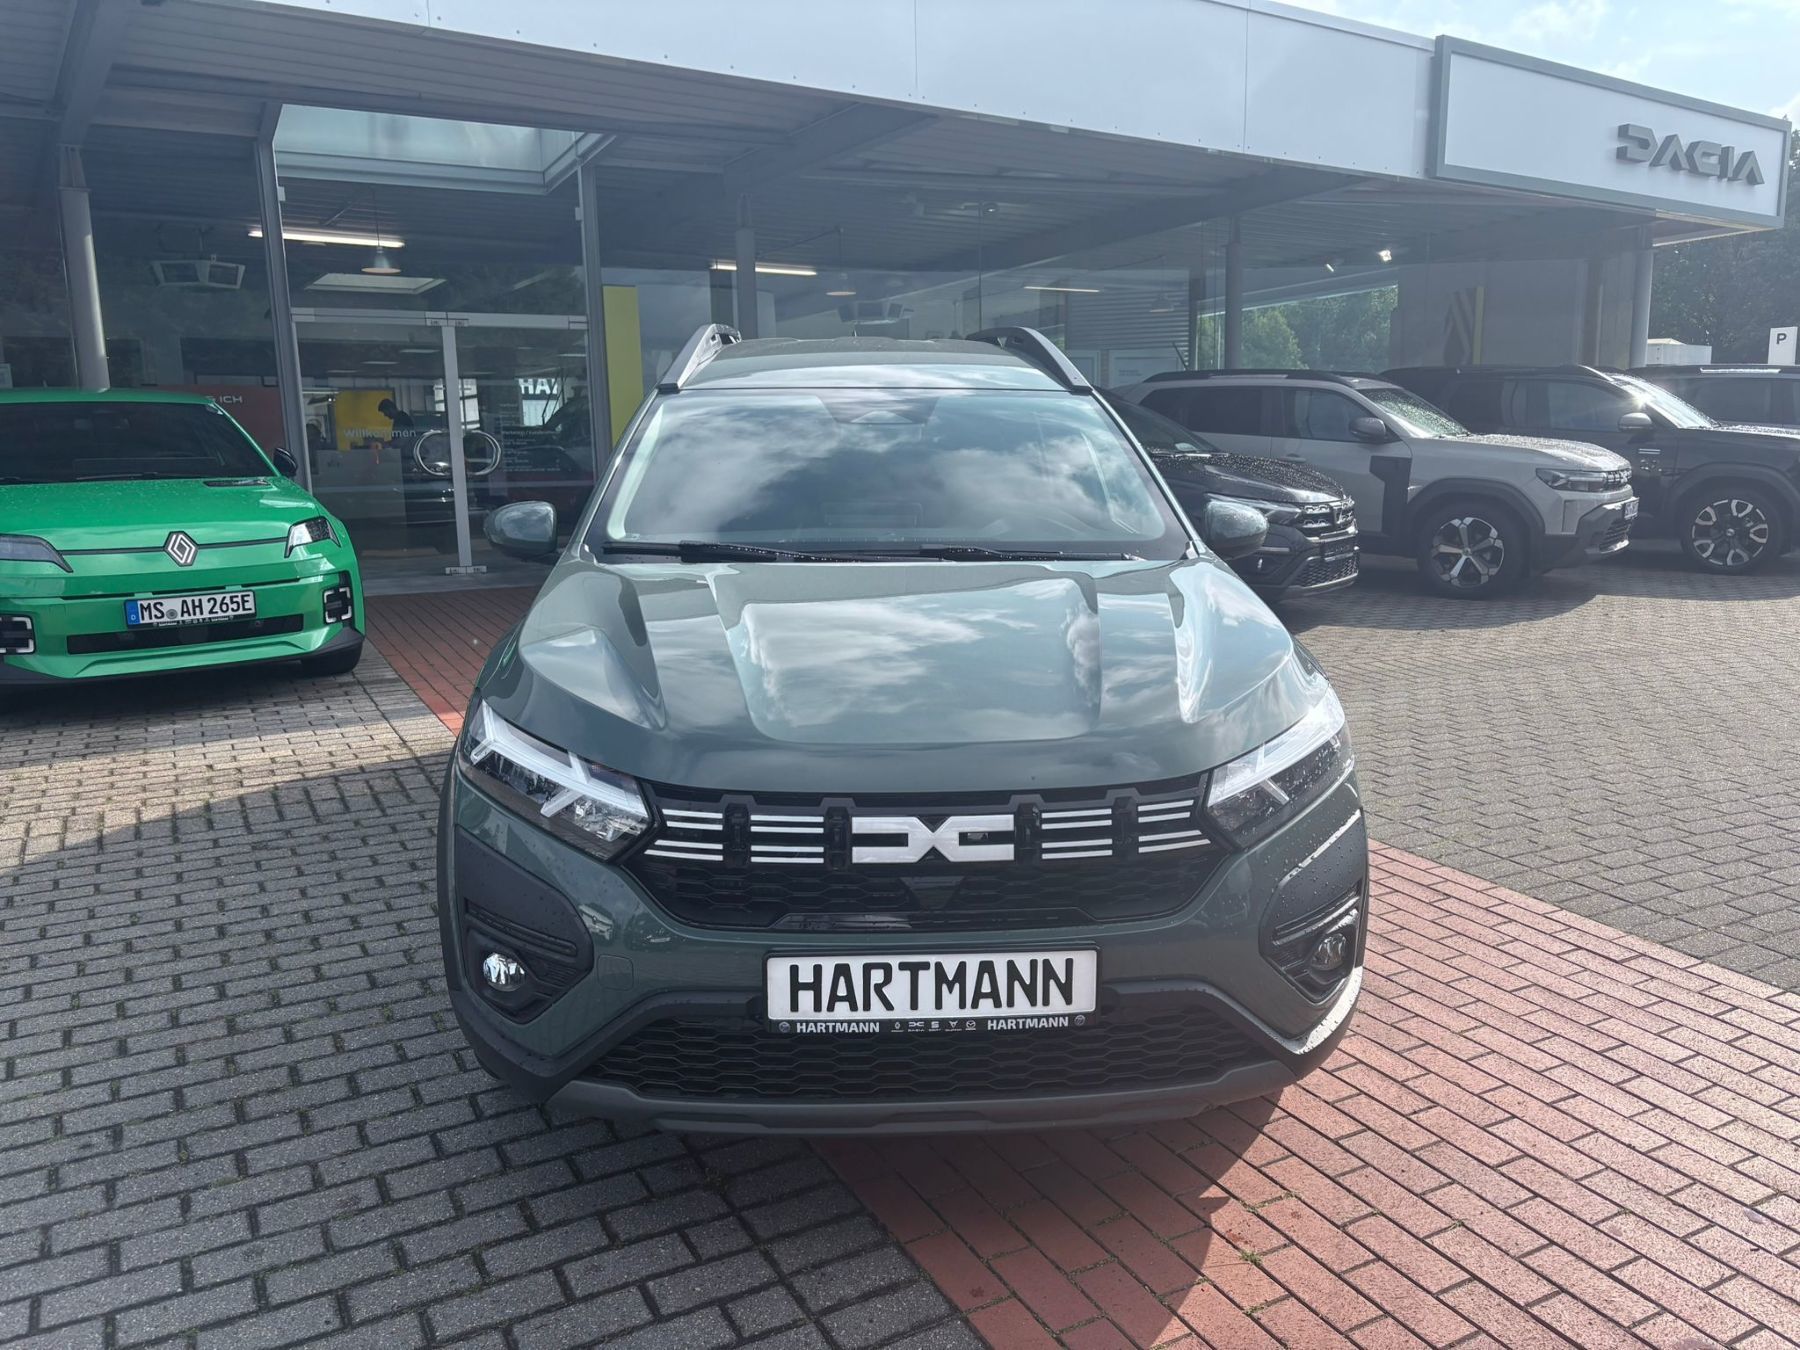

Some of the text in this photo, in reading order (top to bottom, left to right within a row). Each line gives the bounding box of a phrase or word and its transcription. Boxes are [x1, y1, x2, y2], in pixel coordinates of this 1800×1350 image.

[1616, 123, 1765, 186] DACIA
[1776, 332, 1788, 345] P
[140, 594, 253, 621] MS AH 265E
[789, 957, 1074, 1013] HARTMANN
[796, 1022, 880, 1033] HARTMANN
[987, 1016, 1070, 1031] HARTMANN
